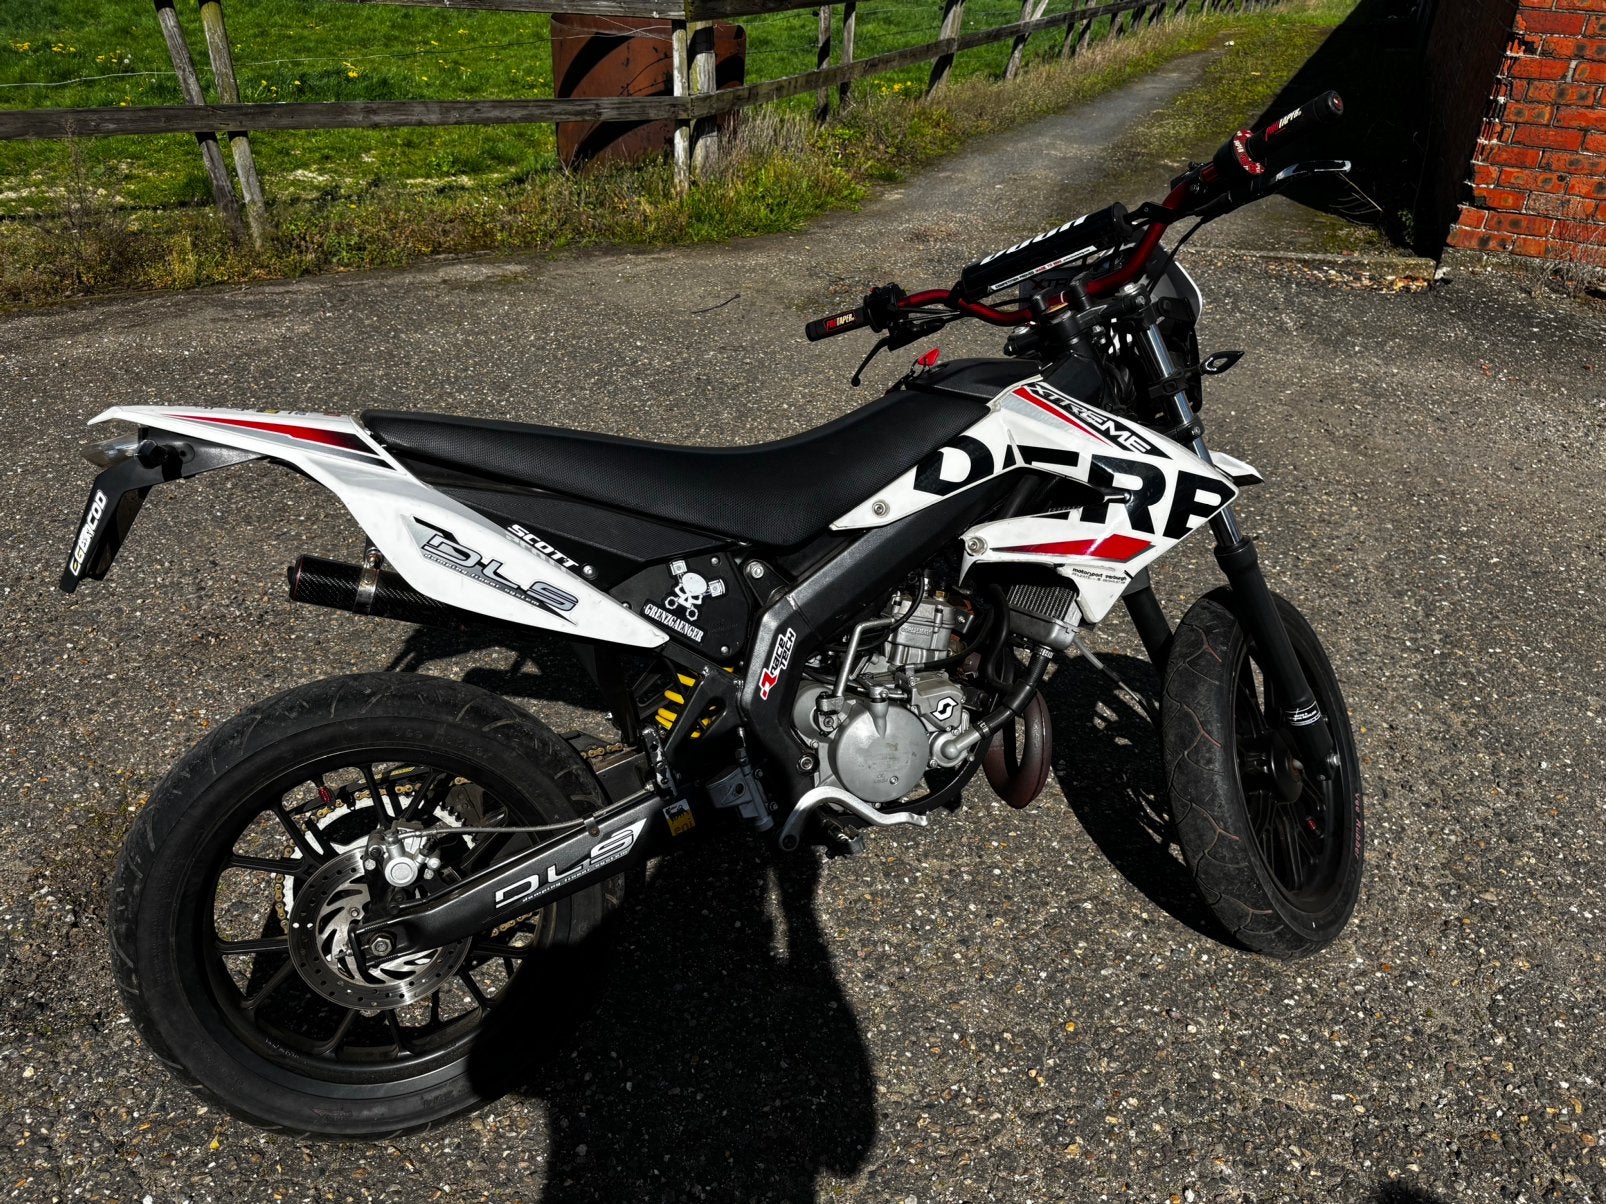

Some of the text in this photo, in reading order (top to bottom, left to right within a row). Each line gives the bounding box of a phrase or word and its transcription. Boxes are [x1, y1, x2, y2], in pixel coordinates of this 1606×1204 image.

[1027, 385, 1151, 454] XTREME
[421, 533, 579, 612] DLS
[506, 523, 580, 569] SCOTT
[643, 603, 704, 642] GRENZGAENGER
[495, 827, 635, 909] DLS
